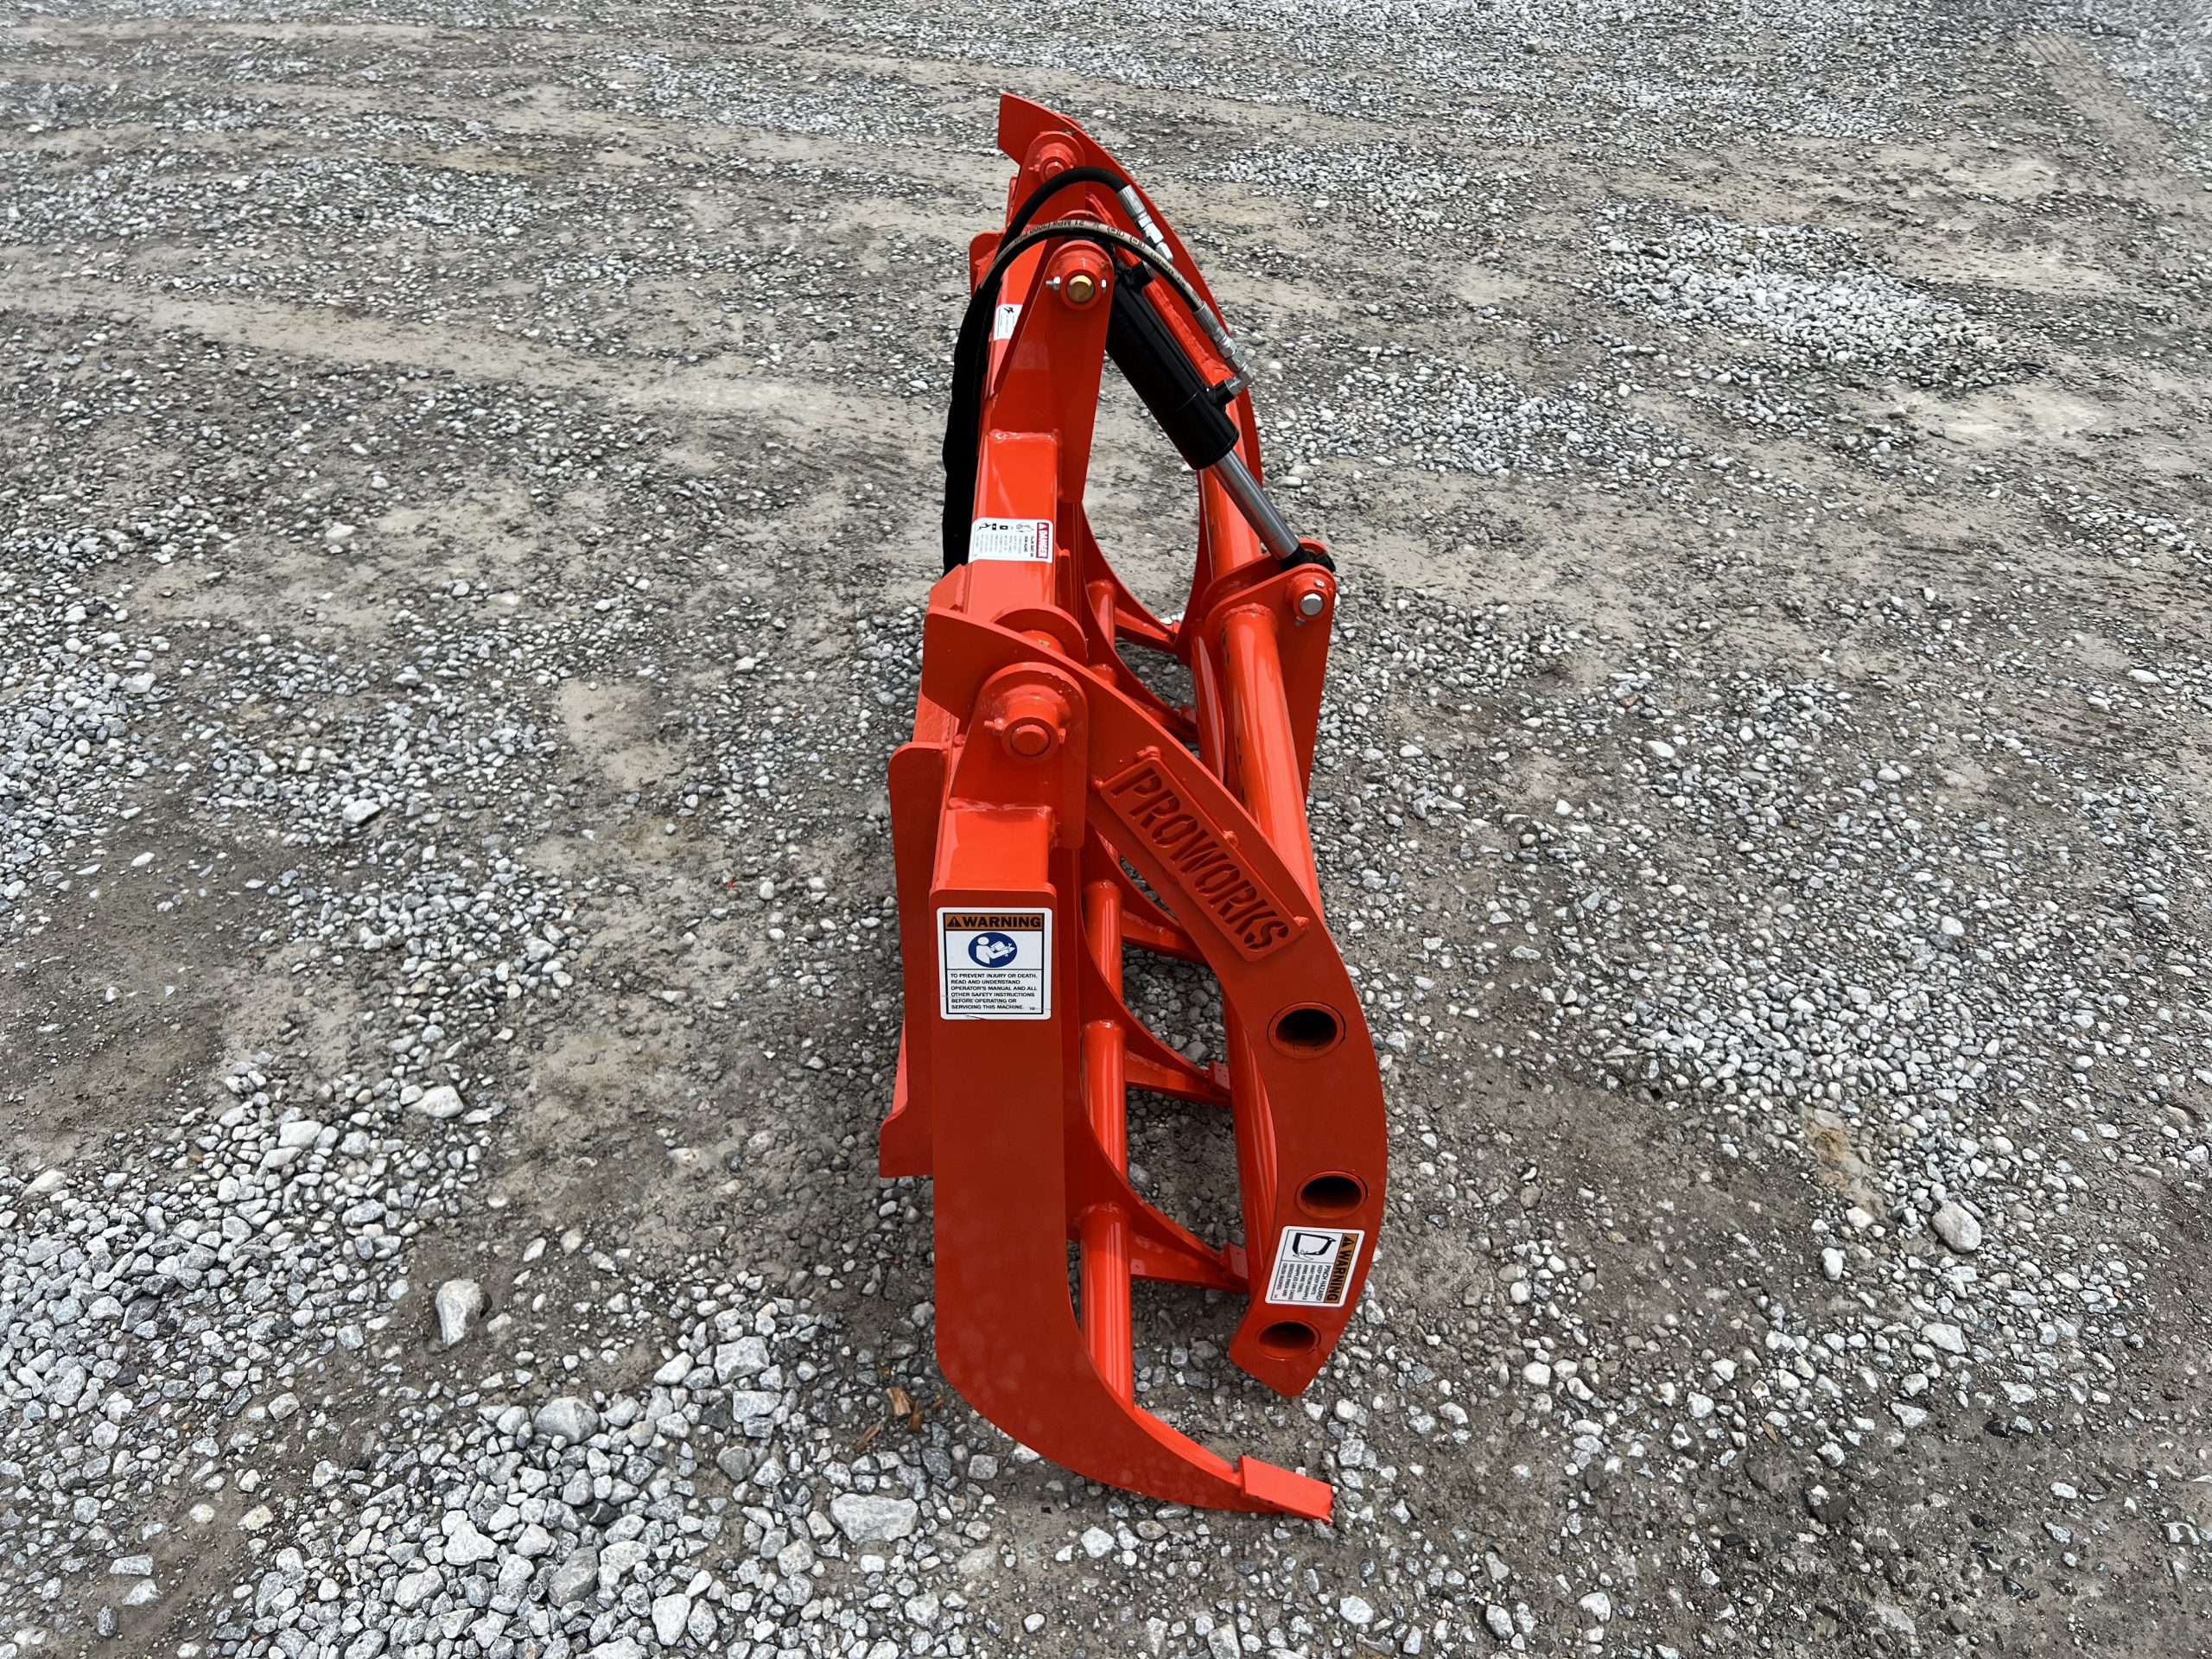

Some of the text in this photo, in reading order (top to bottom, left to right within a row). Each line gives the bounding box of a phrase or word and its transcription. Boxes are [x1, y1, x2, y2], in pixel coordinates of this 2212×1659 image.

[1038, 530, 1048, 557] DANGER
[1110, 767, 1289, 950] PROWORKS
[962, 916, 1041, 927] WARNING
[1322, 1265, 1331, 1280] PINCH
[1326, 1250, 1352, 1300] WARNING
